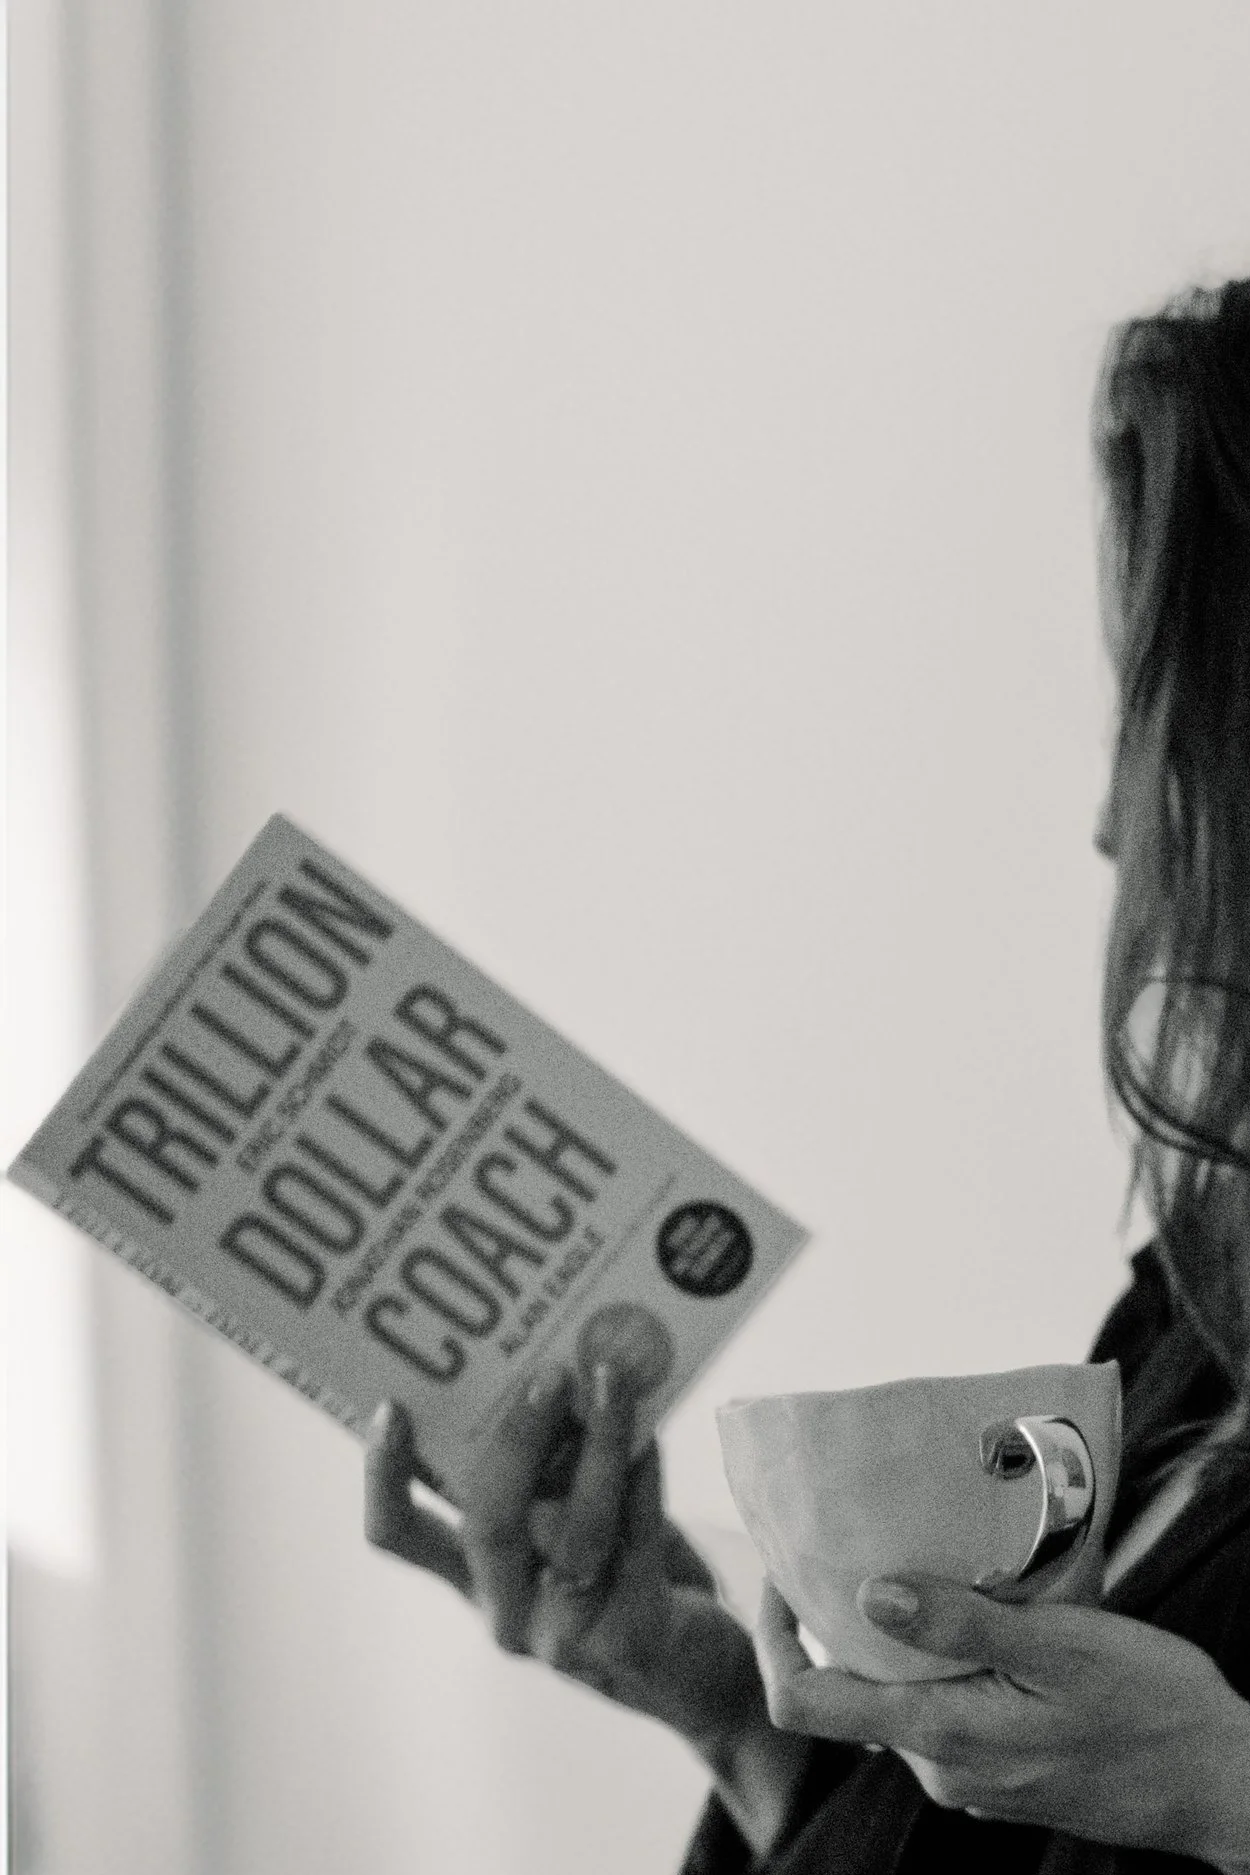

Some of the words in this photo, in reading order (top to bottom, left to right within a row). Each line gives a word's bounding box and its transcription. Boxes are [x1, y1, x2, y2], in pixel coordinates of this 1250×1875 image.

[69, 859, 394, 1224] TRILLION
[216, 984, 507, 1312] DOLLAR
[234, 1118, 286, 1178] ERIC
[362, 1099, 616, 1386] COACH
[498, 1298, 550, 1359] ALAN
[543, 1226, 604, 1300] EAGLE
